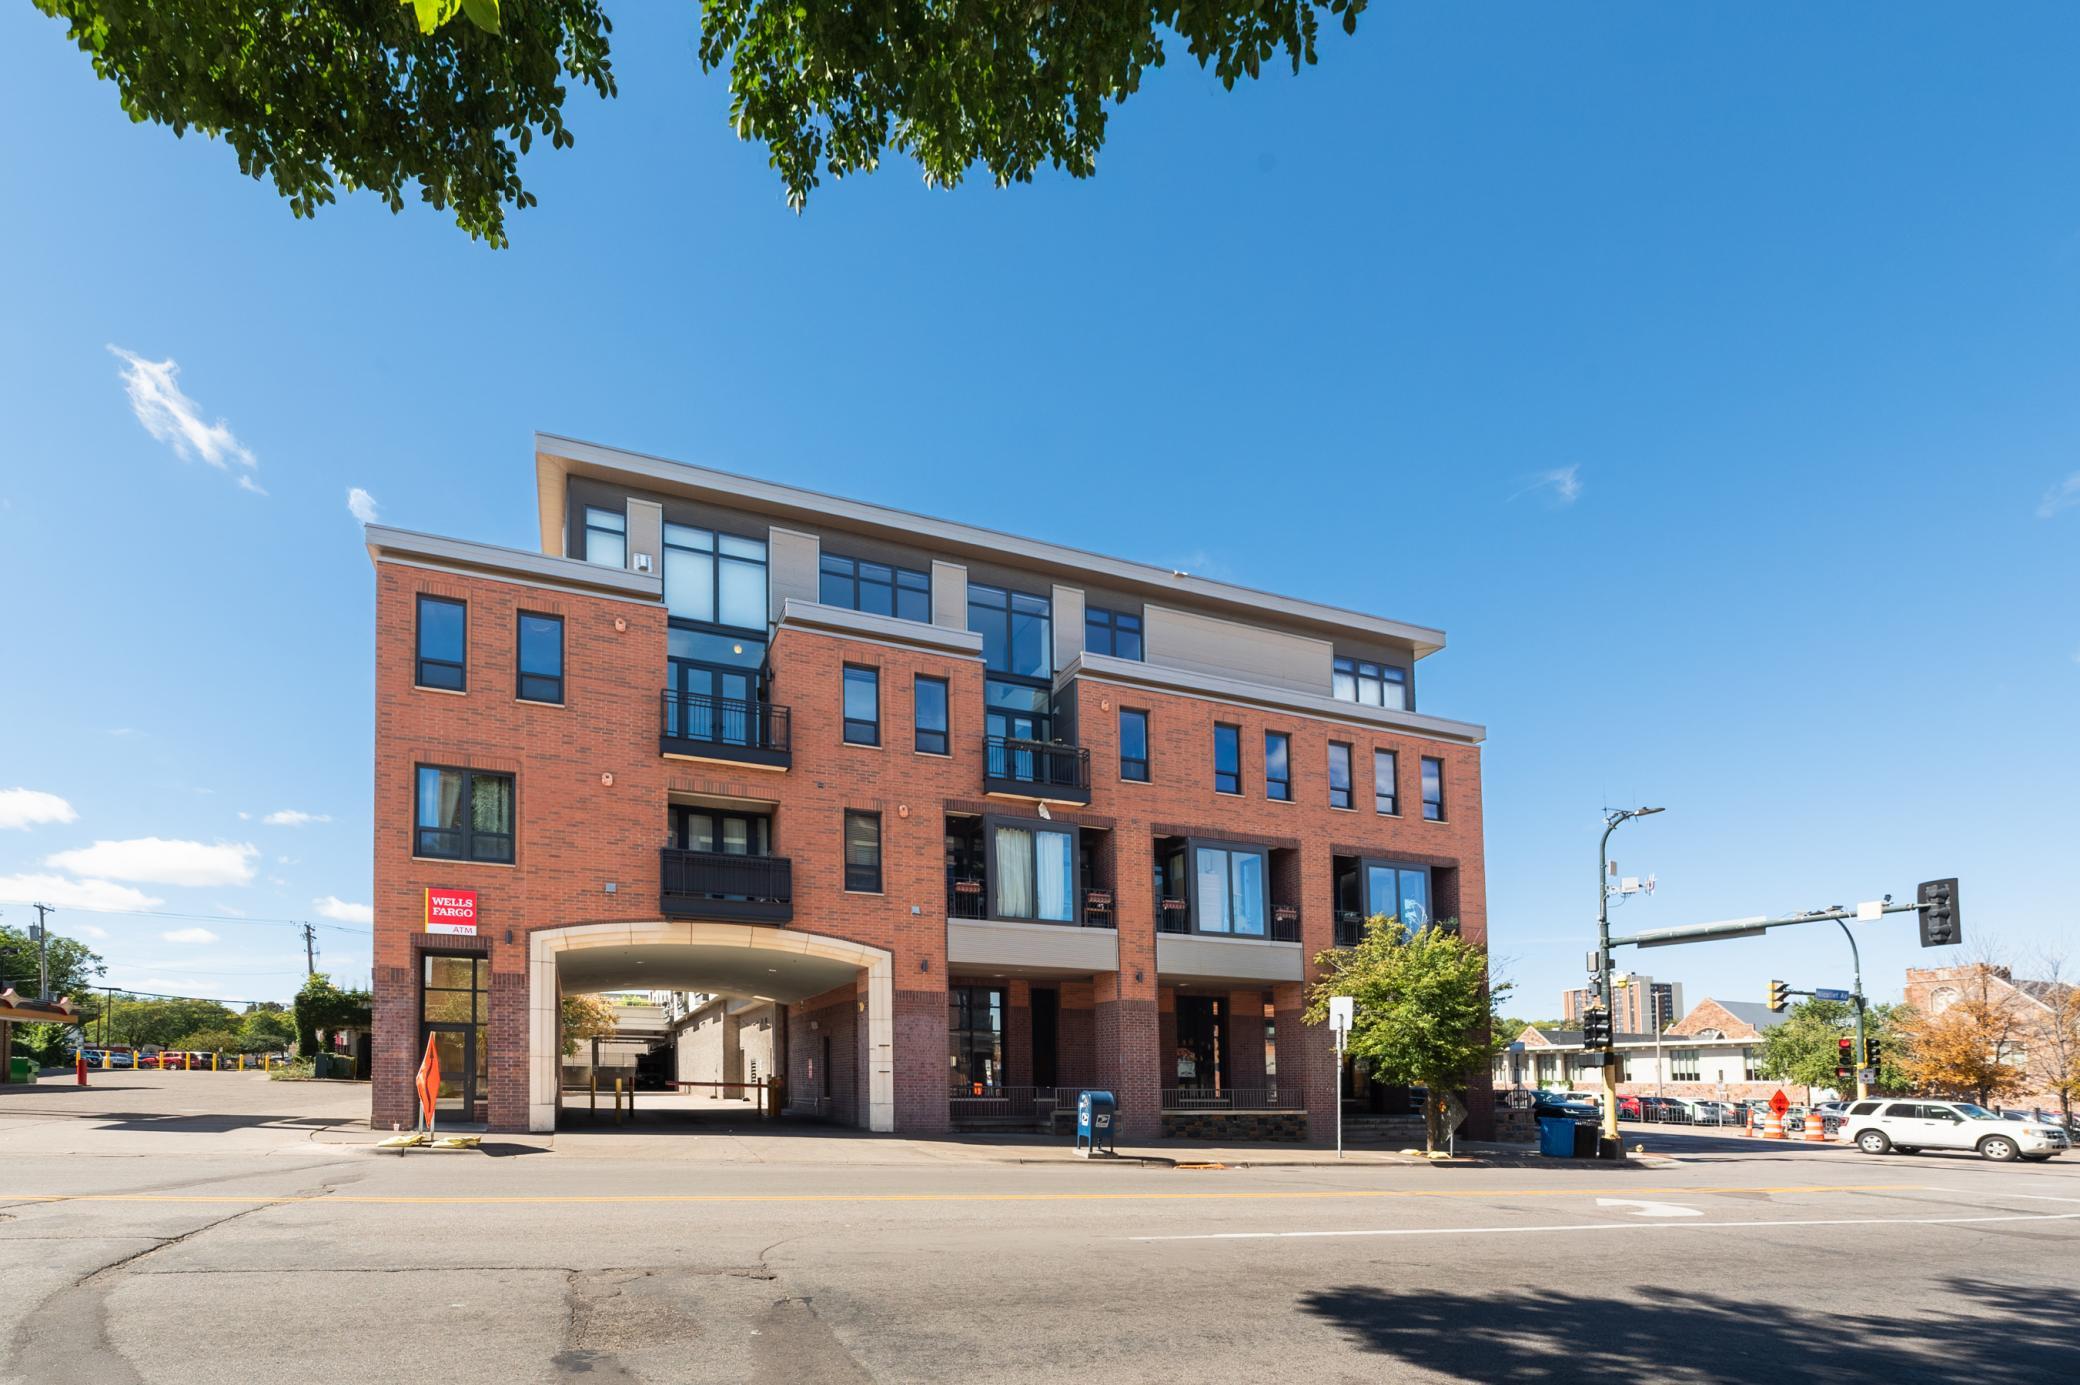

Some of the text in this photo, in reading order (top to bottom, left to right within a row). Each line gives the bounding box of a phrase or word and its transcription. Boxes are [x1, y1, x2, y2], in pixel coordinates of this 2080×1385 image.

[432, 897, 473, 908] WELLS
[432, 907, 474, 917] FARGO
[452, 926, 473, 934] ATM
